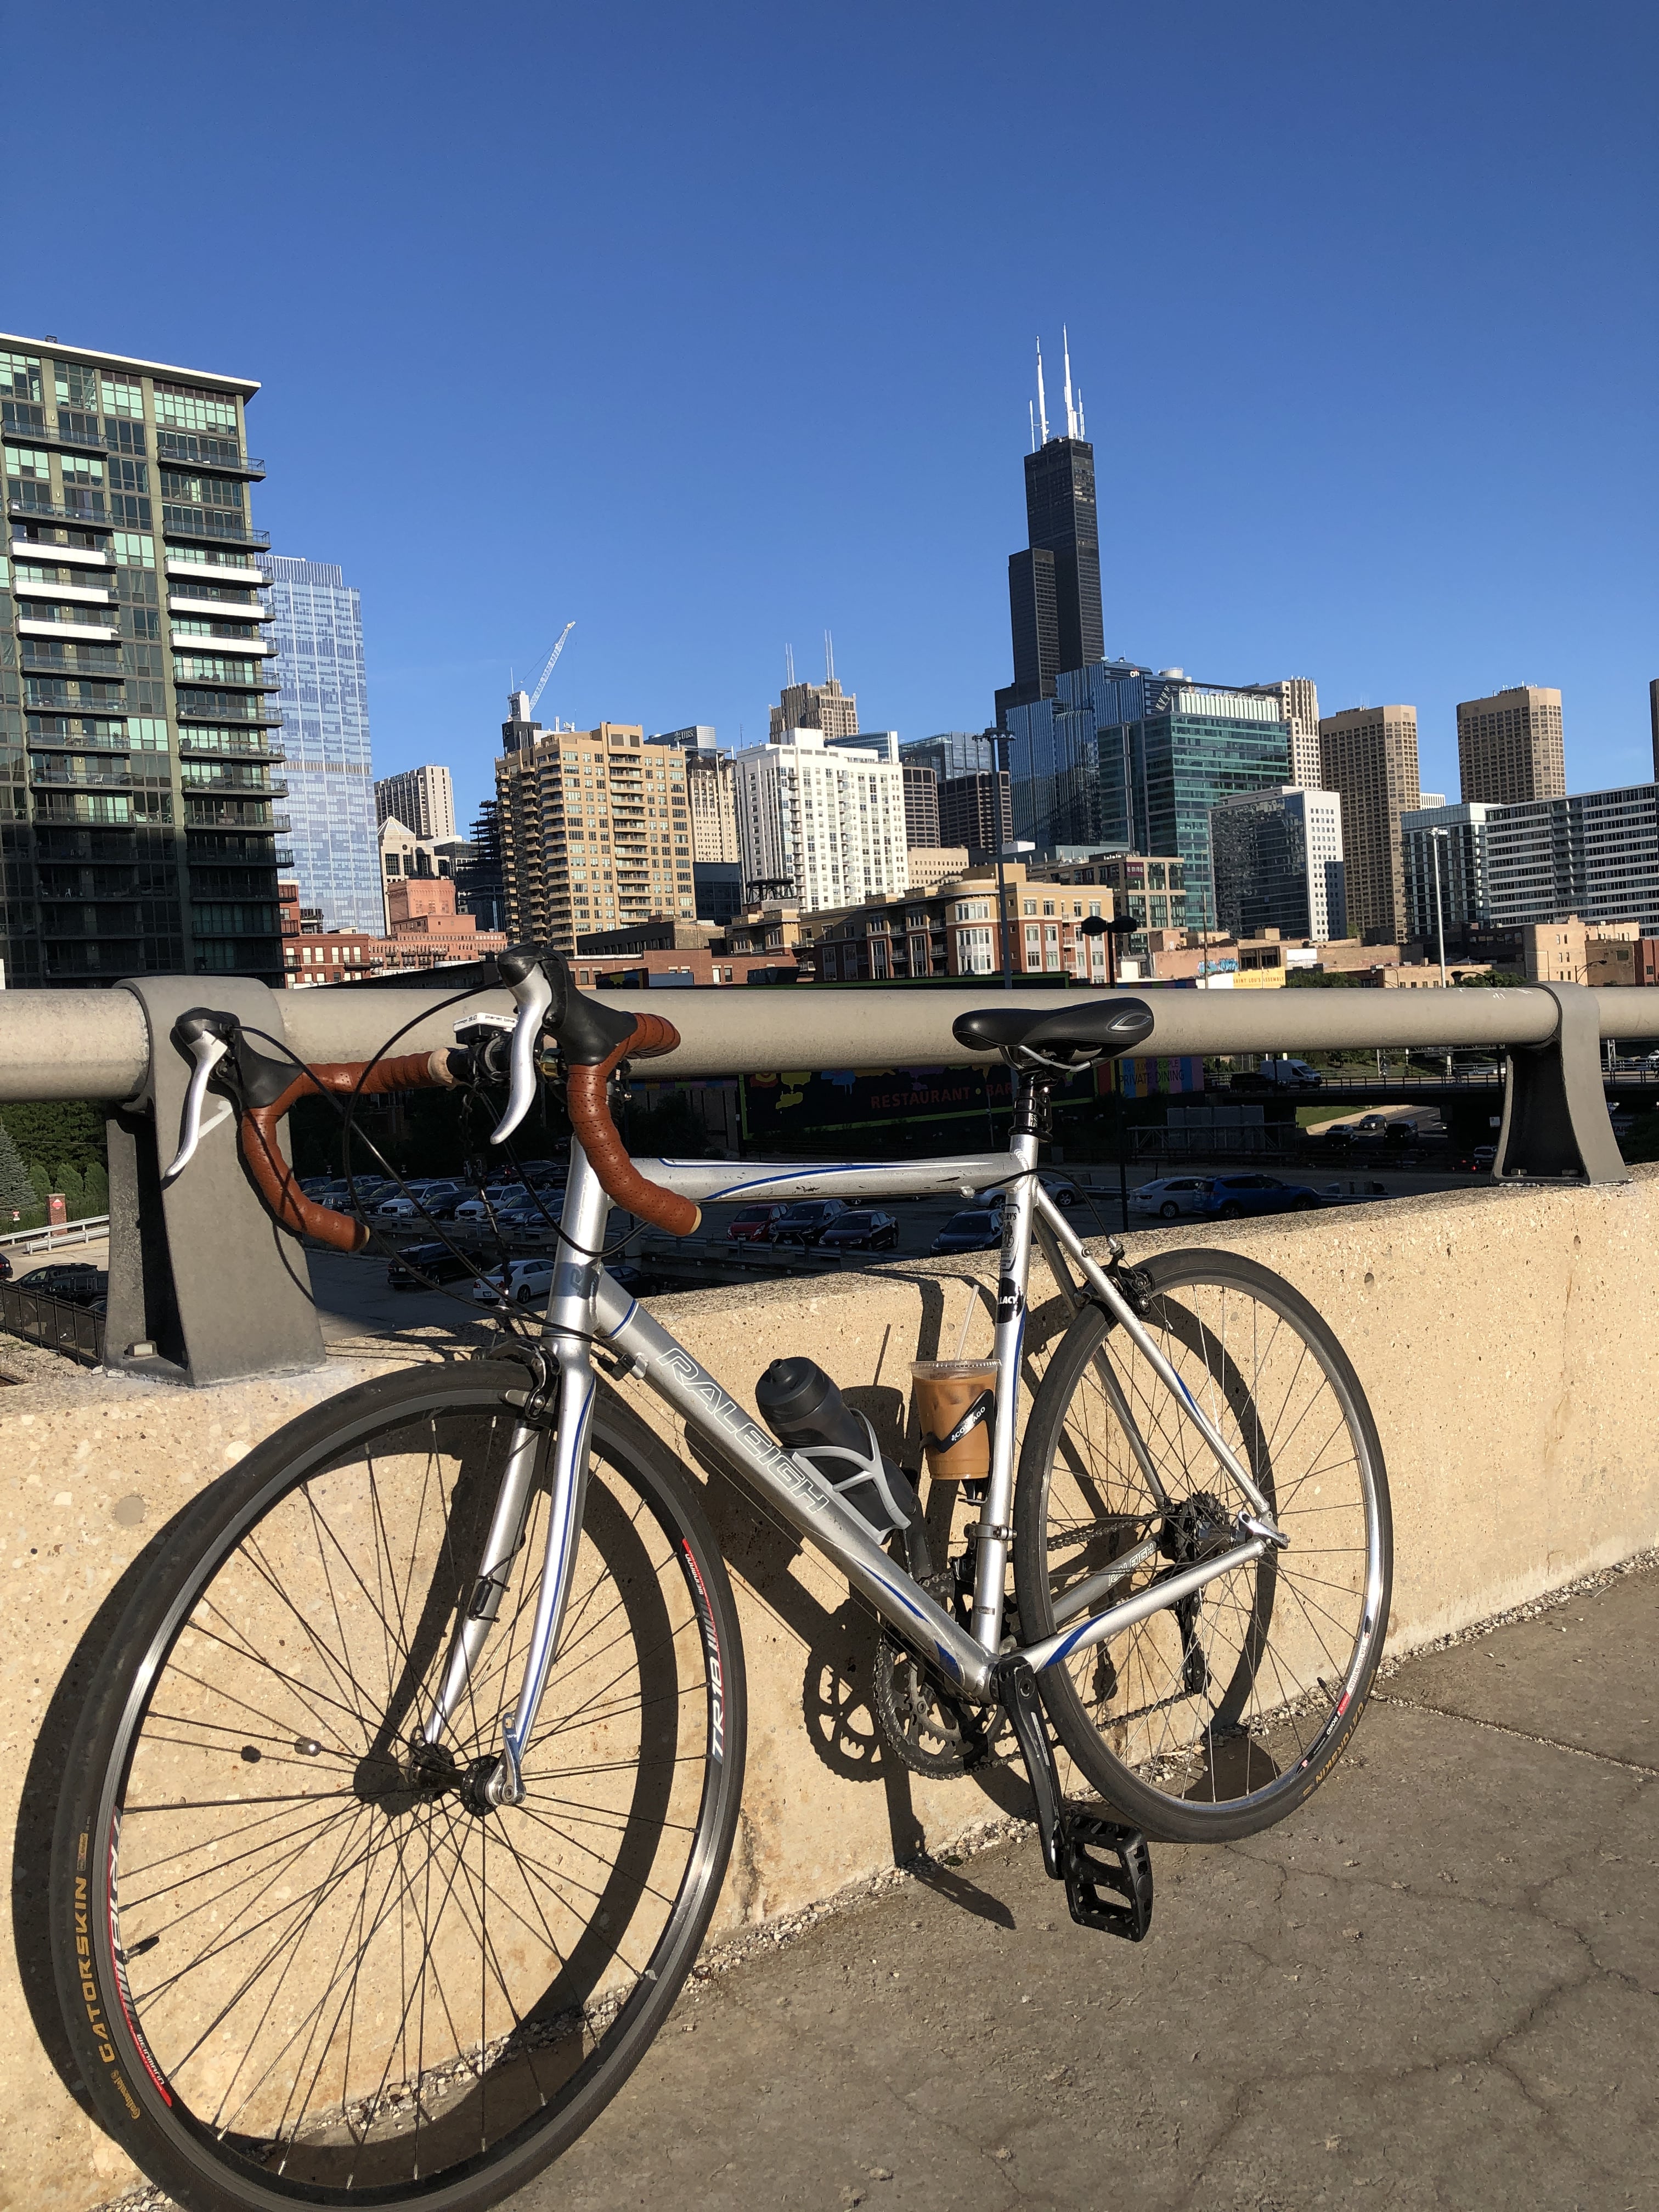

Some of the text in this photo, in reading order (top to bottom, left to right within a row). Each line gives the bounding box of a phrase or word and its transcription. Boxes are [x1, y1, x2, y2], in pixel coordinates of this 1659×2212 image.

[681, 730, 693, 740] UBS
[870, 1082, 1012, 1109] RESTAURANT BAR
[1120, 1069, 1184, 1086] PRIVATE DINING
[657, 1347, 831, 1514] RALEIGH
[685, 1554, 703, 1595] WEINMANN
[1108, 1543, 1154, 1586] RALEIGH
[1316, 1702, 1363, 1784] GATORSKIN
[1327, 1716, 1339, 1735] ROAD
[75, 1877, 116, 2063] GATORSKIN
[137, 2034, 165, 2085] WEINMANN
[113, 2075, 141, 2119] Continental
